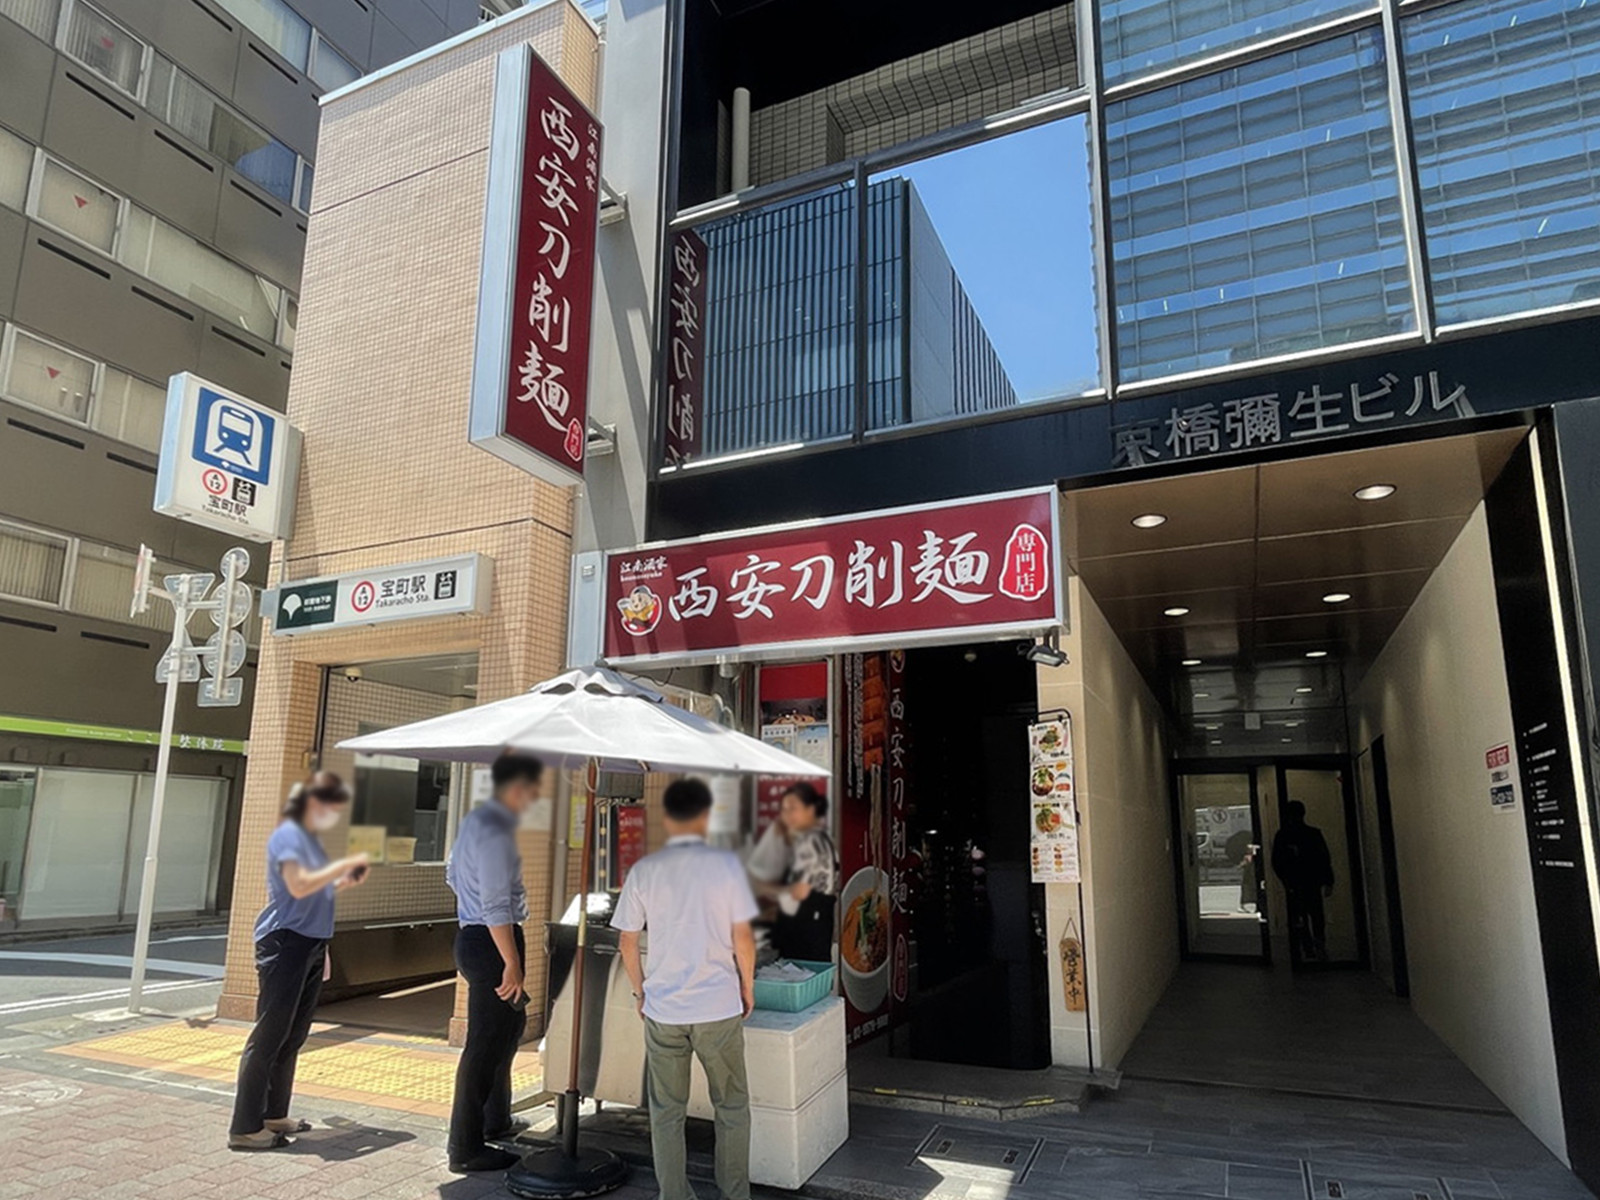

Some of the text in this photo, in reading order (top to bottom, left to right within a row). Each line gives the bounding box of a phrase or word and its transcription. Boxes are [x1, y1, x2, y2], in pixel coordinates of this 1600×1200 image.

[516, 96, 580, 432] 西安刀削麺
[210, 480, 221, 490] 12
[208, 494, 247, 517] 宝町駅
[1016, 533, 1036, 593] 専門店
[381, 574, 427, 598] 宝町駅
[668, 529, 994, 622] 西安刀削麺
[358, 595, 369, 606] 12
[360, 587, 367, 595] A
[375, 597, 414, 609] Takaracho
